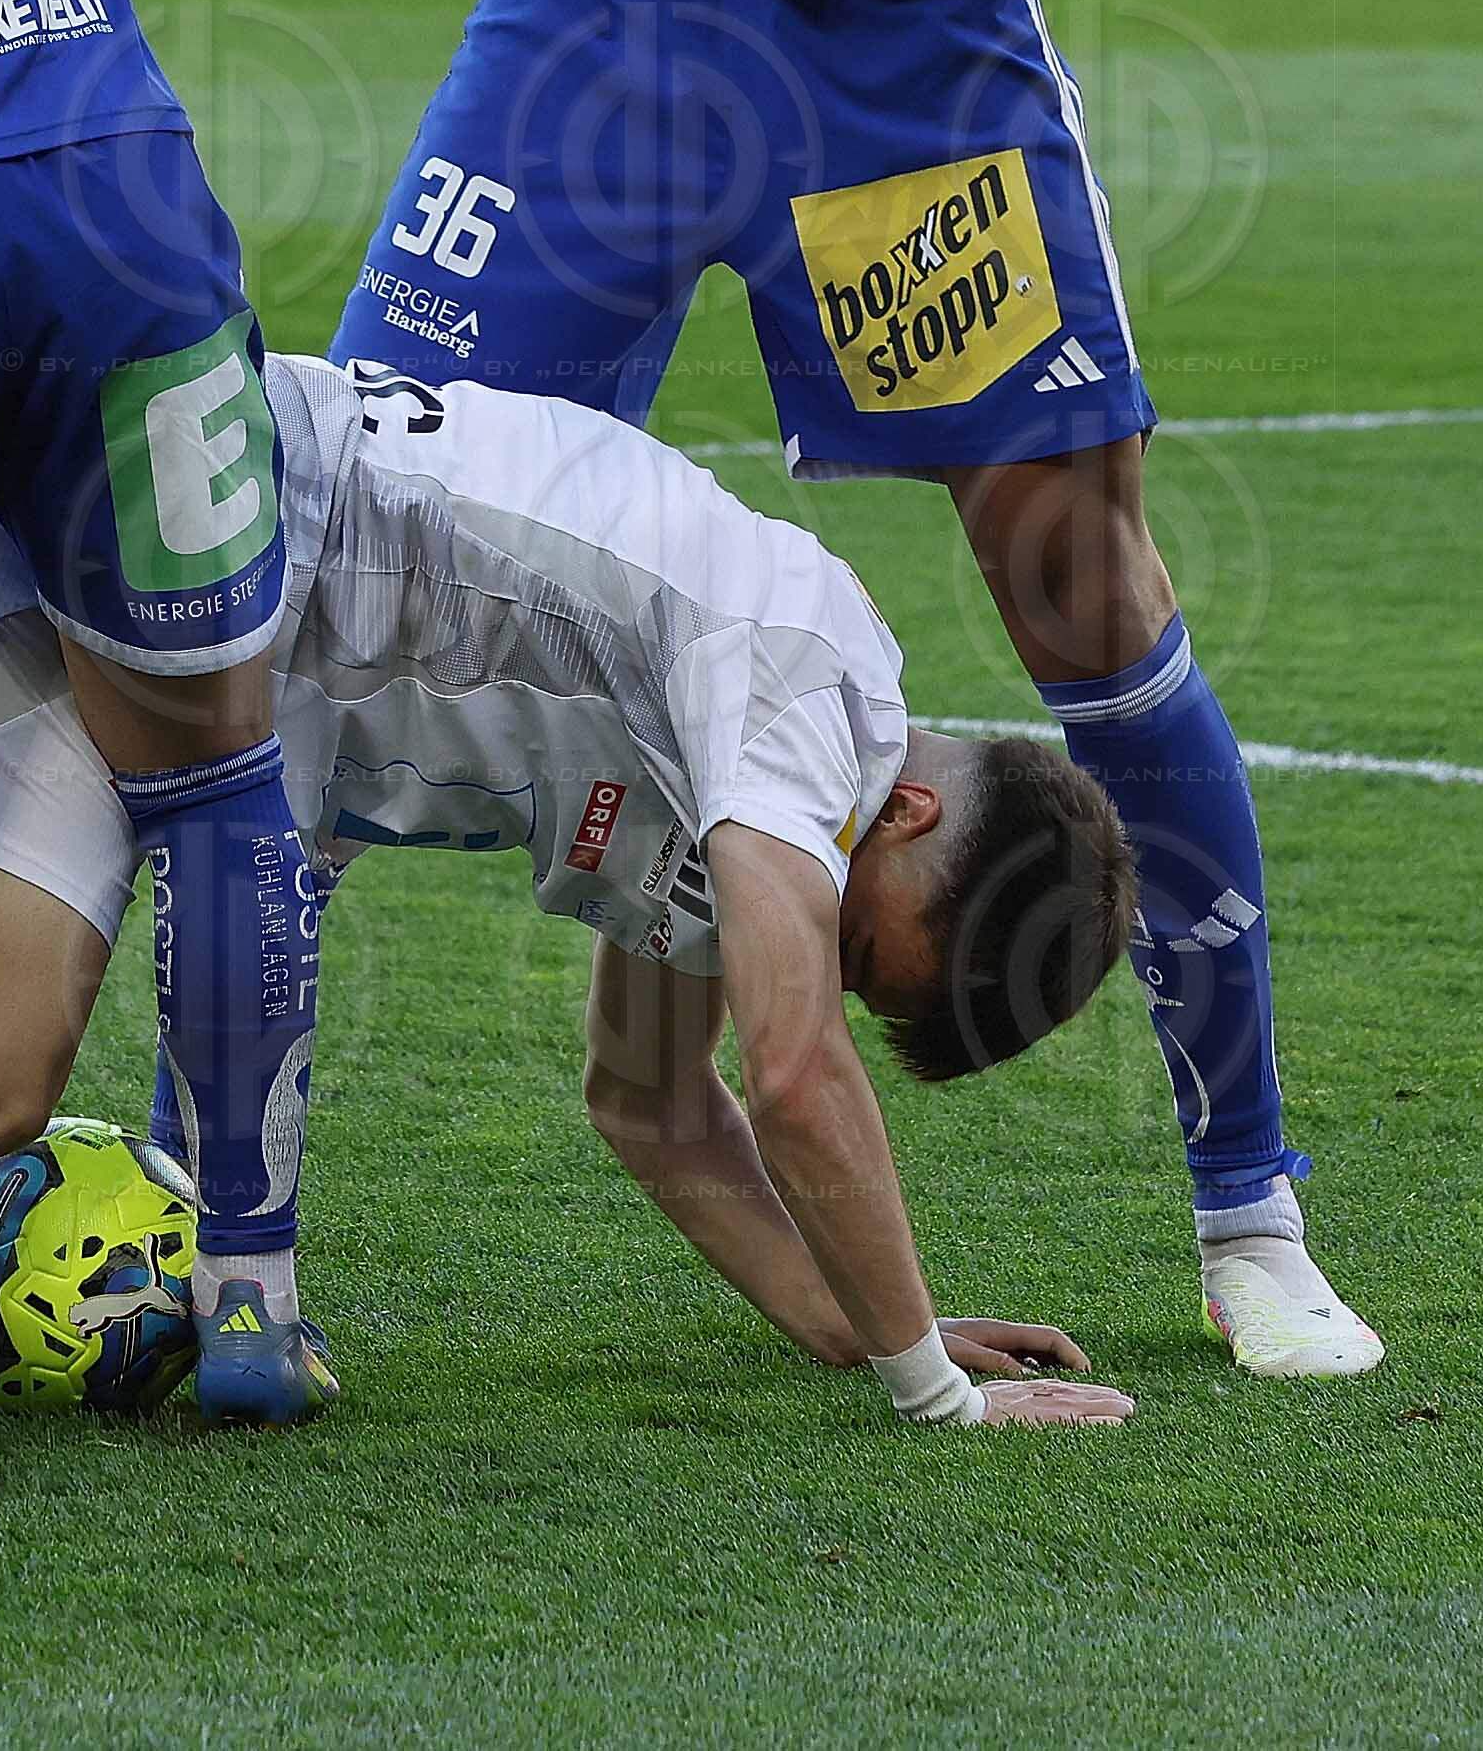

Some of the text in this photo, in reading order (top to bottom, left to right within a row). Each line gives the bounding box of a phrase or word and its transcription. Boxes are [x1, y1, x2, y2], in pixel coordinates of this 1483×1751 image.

[391, 156, 516, 279] 36
[822, 162, 1009, 350] boxxen
[383, 304, 475, 359] Hartberg
[866, 249, 1009, 398] stopp
[127, 593, 224, 622] ENERGIE
[585, 787, 616, 842] ORF
